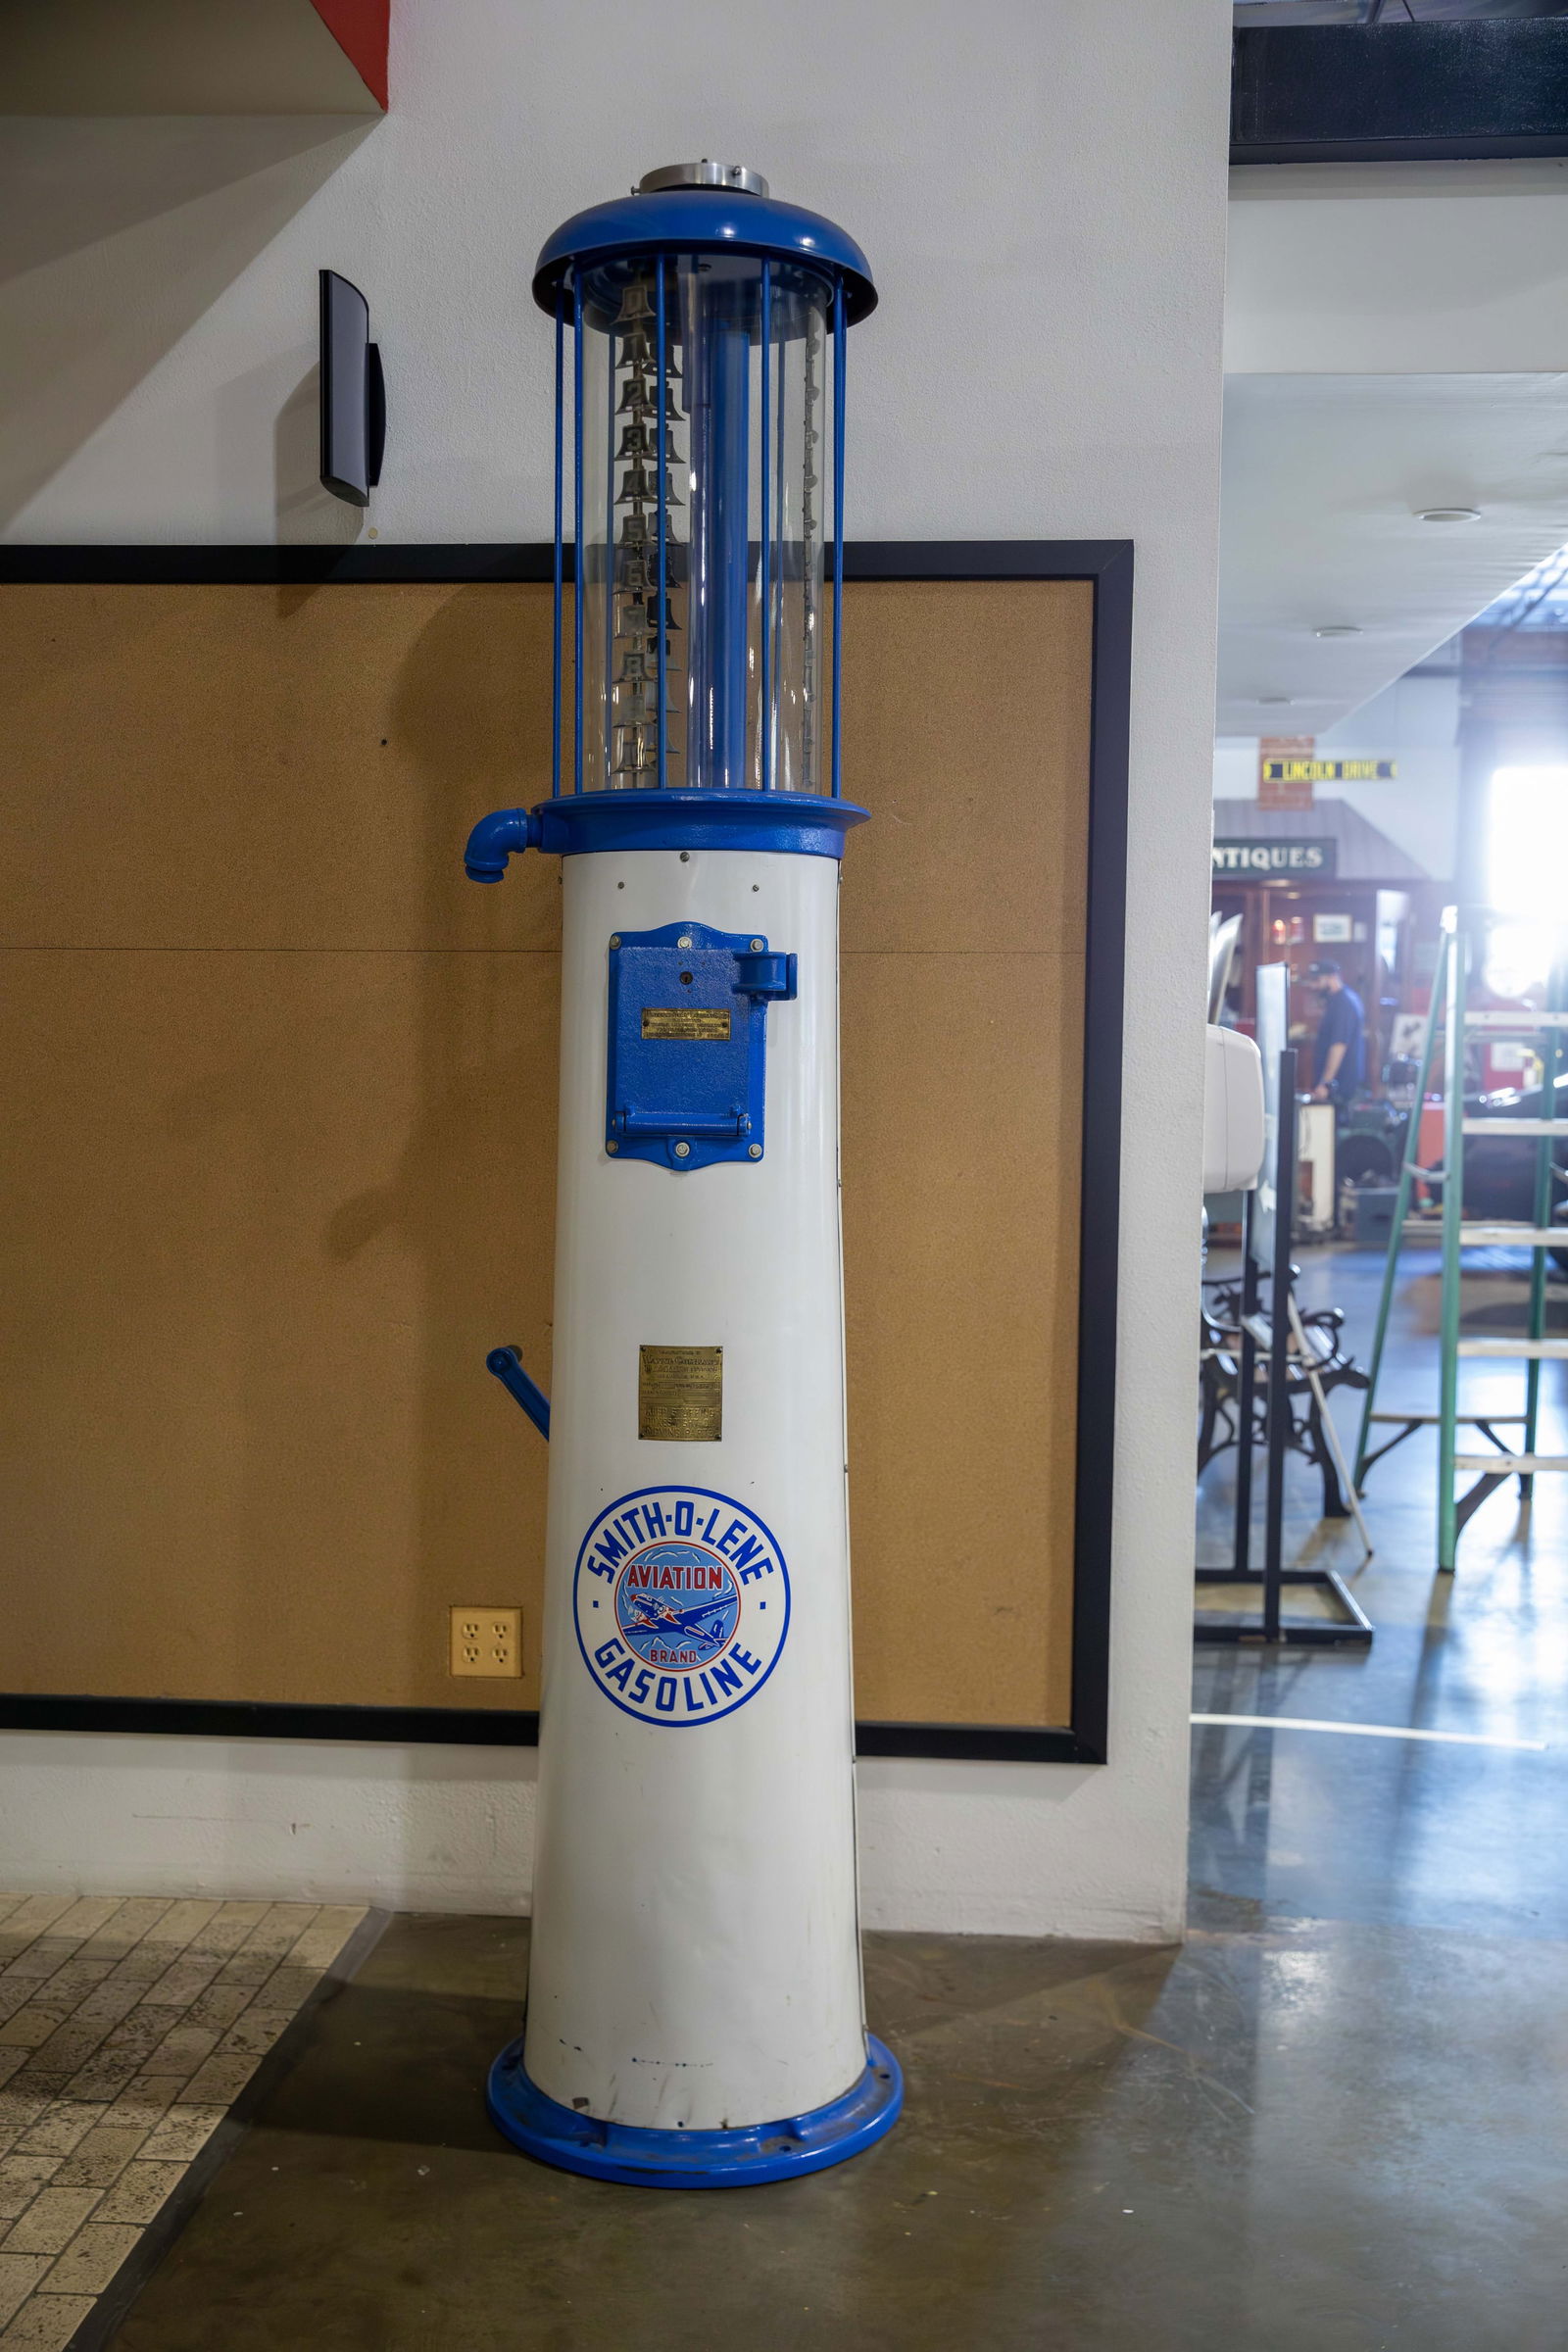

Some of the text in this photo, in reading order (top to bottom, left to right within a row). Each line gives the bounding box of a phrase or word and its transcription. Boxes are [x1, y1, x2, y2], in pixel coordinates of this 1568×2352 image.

[626, 381, 643, 406] 2
[626, 428, 642, 452] 3
[624, 472, 641, 495] 4
[627, 519, 643, 542] 5
[626, 564, 643, 587] 6
[625, 656, 642, 677] 8
[1283, 760, 1378, 780] LINCOLN DRIVE
[1212, 847, 1323, 870] NTIQUES
[627, 1565, 723, 1590] AVIATION
[650, 1648, 698, 1663] BRAND
[594, 1637, 761, 1712] GASOLINE
